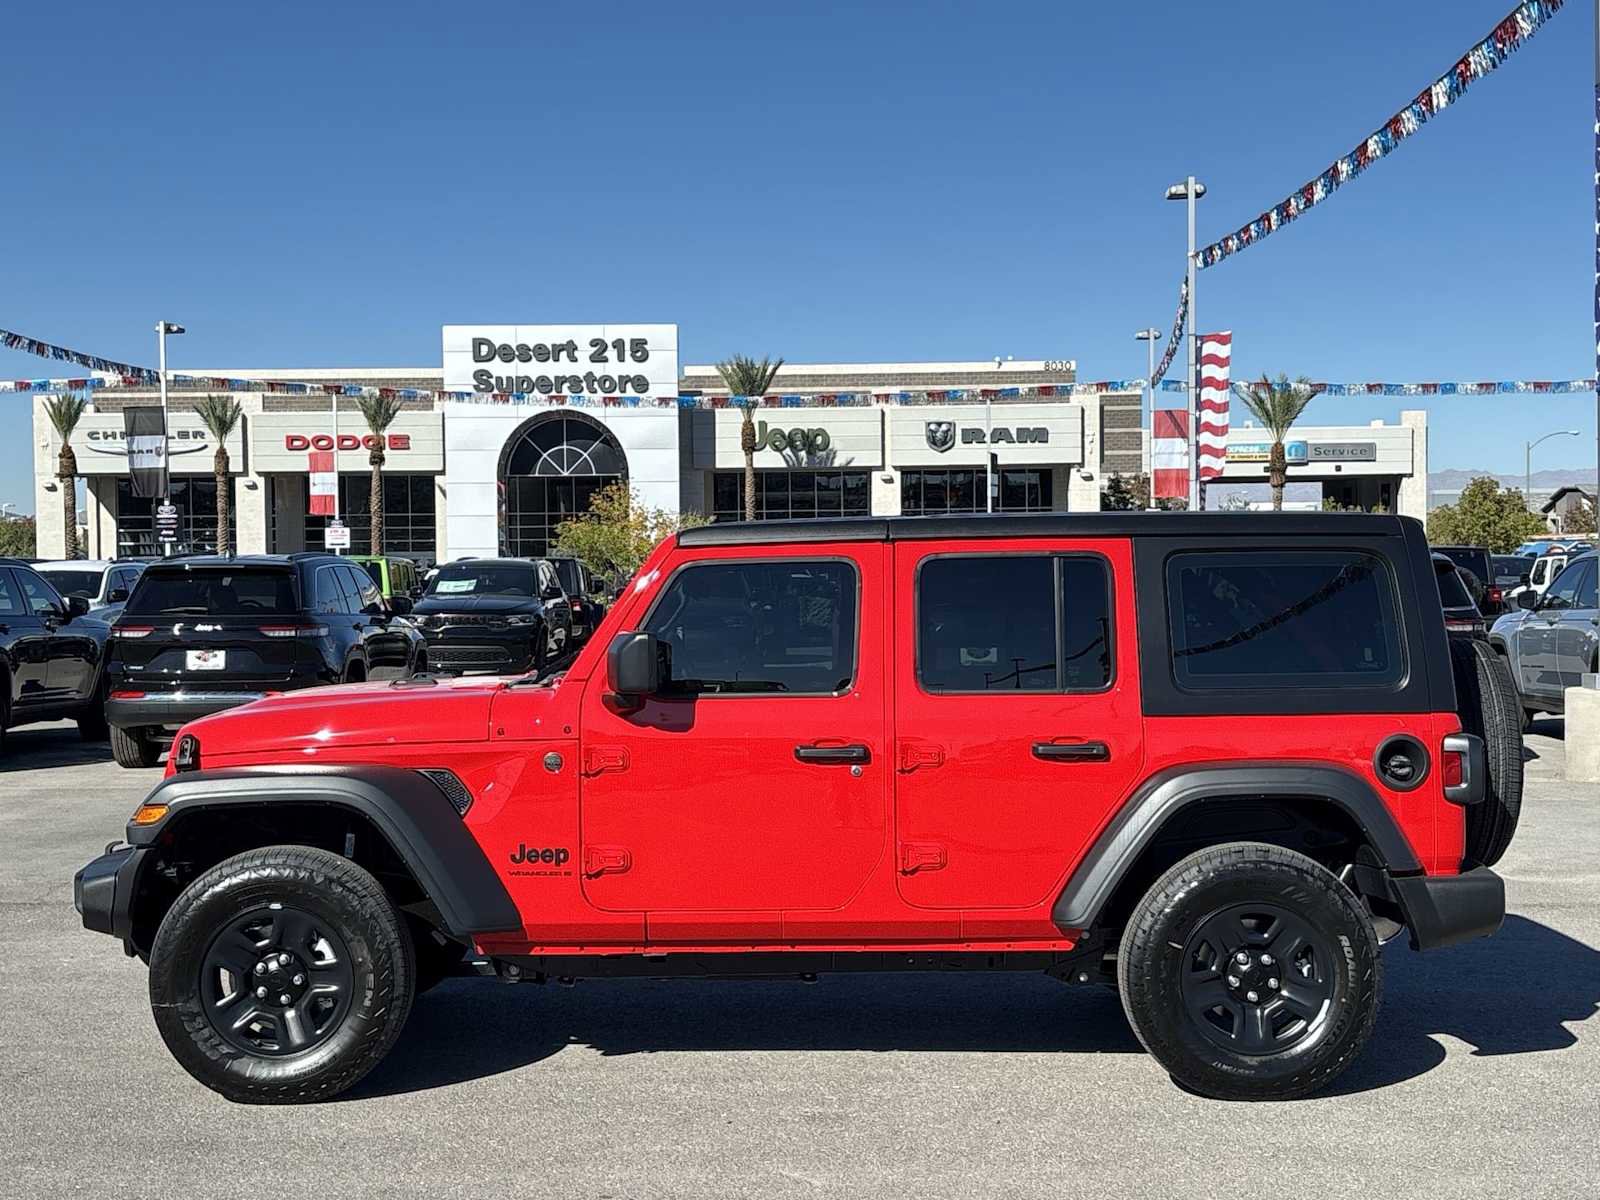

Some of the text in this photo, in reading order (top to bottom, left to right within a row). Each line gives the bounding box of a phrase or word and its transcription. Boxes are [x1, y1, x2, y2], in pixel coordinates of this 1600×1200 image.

[472, 337, 649, 363] Desert 215
[1044, 360, 1072, 371] 8030
[472, 369, 649, 396] Superstore
[753, 420, 830, 452] Jeep
[961, 427, 1049, 443] RAM
[1313, 446, 1369, 456] Service
[510, 843, 570, 867] Jeep
